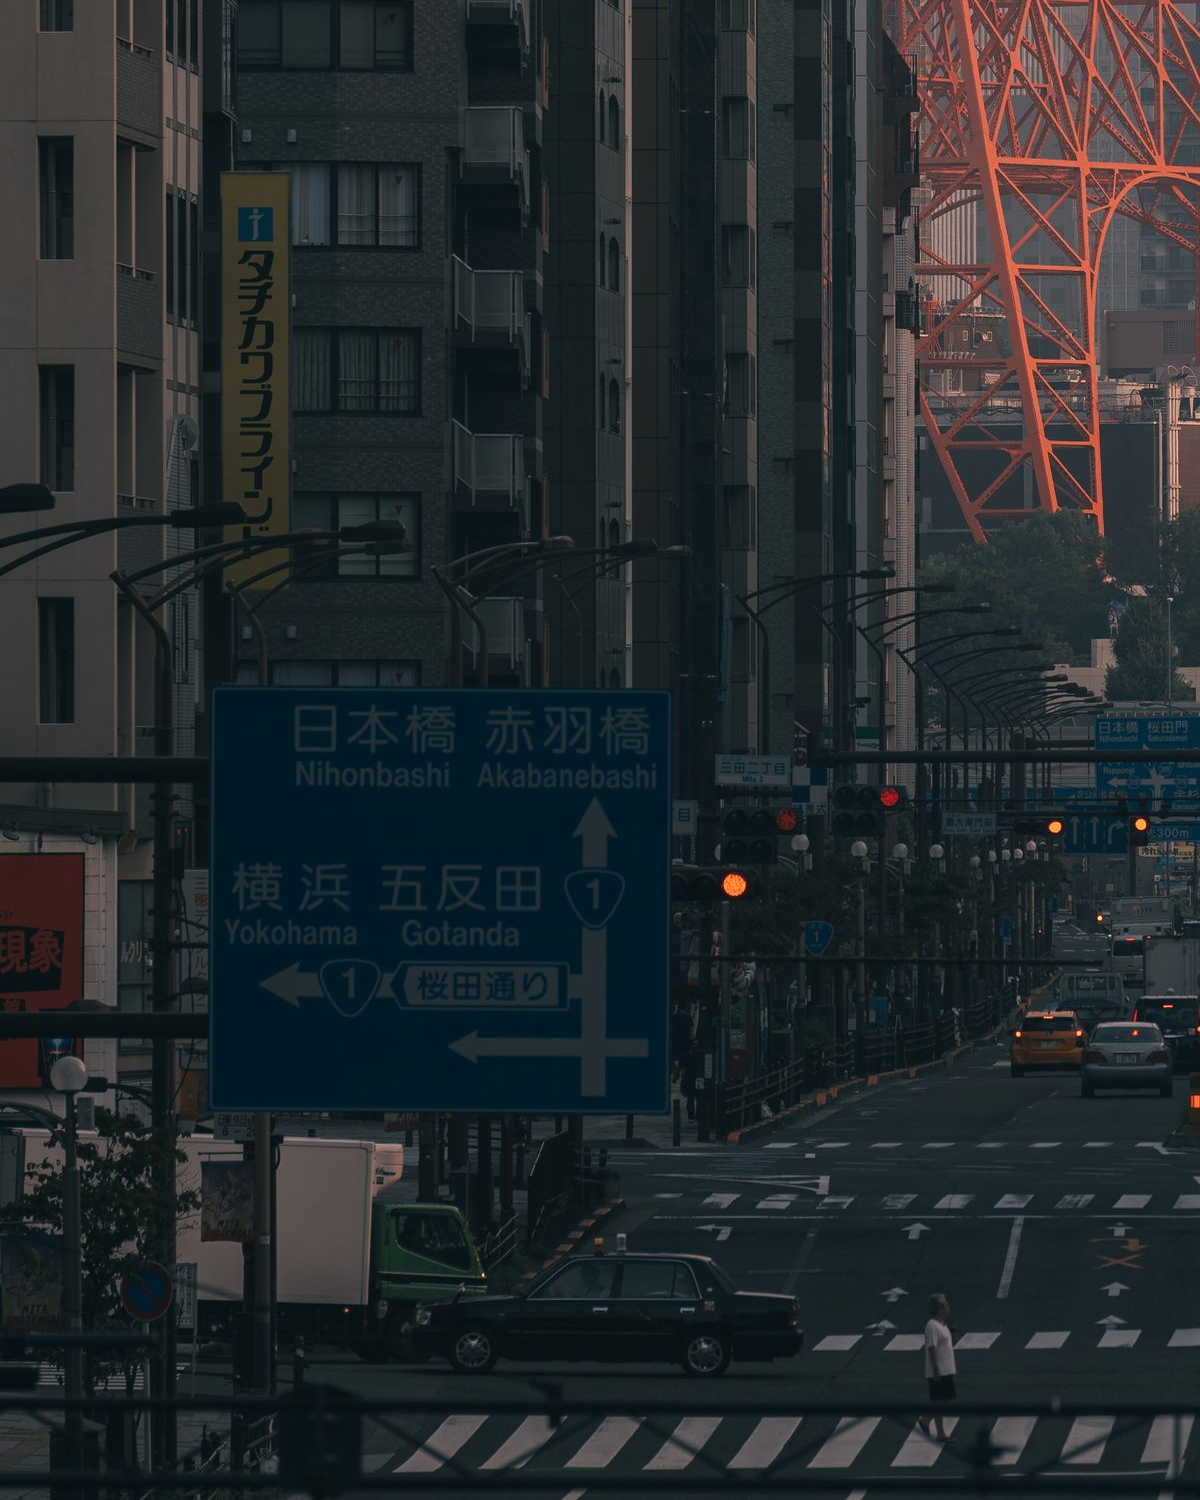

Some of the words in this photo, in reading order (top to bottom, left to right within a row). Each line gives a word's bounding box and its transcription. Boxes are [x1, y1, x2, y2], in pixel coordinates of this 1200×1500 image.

[237, 250, 275, 559] タチカワブラインド
[294, 704, 457, 755] 日本橋
[484, 705, 651, 756] 赤羽橋
[1099, 721, 1139, 734] 日本橋
[1147, 720, 1189, 734] 桜田門
[295, 761, 451, 788] Nihonbashi
[477, 762, 656, 789] Akabanebashi
[720, 762, 785, 775] 三田二丁目
[231, 862, 351, 912] 横浜
[378, 864, 541, 912] 五反田
[586, 878, 600, 909] 1
[224, 920, 358, 946] Yokohama
[401, 920, 520, 948] Gotanda
[341, 967, 356, 999] 1
[416, 971, 549, 1001] 桜田通り
